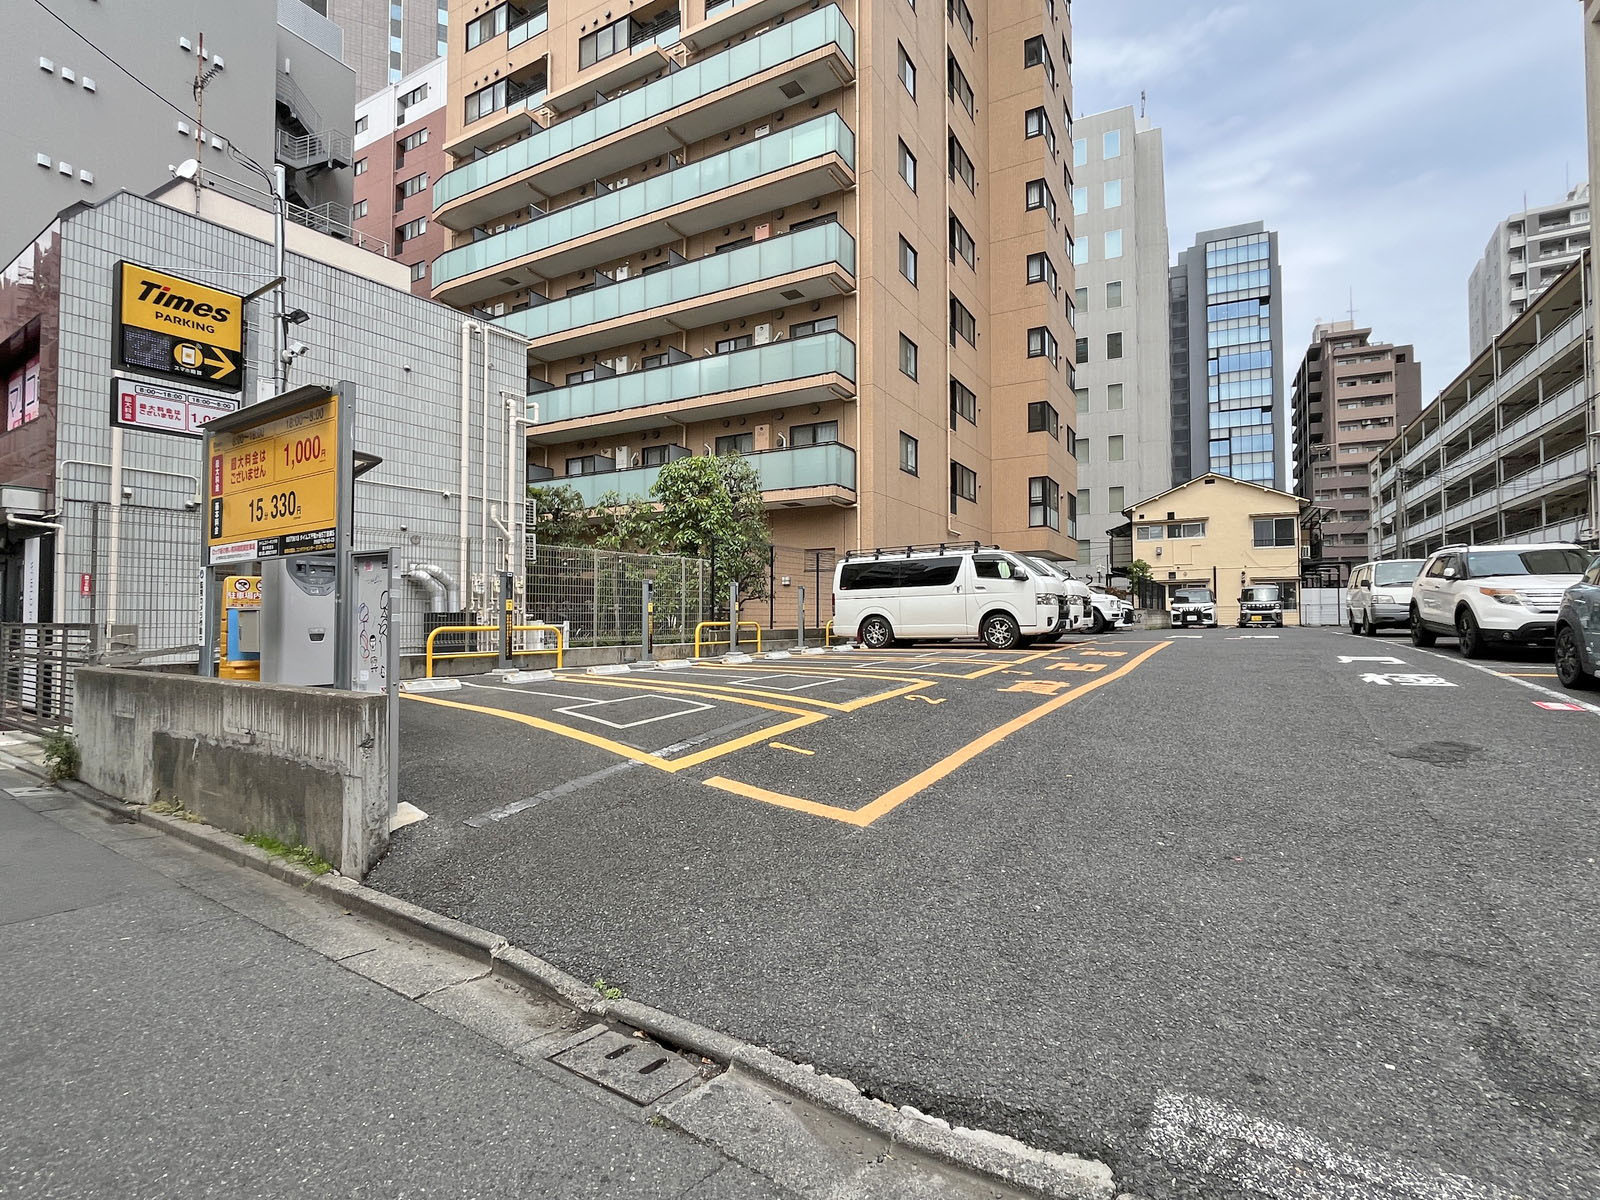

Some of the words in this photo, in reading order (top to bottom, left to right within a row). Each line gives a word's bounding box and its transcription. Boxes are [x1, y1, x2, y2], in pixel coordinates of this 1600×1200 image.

[138, 280, 231, 323] Times
[155, 311, 215, 334] PARKING
[230, 449, 266, 471] 最大料金は
[230, 464, 267, 485] ございません
